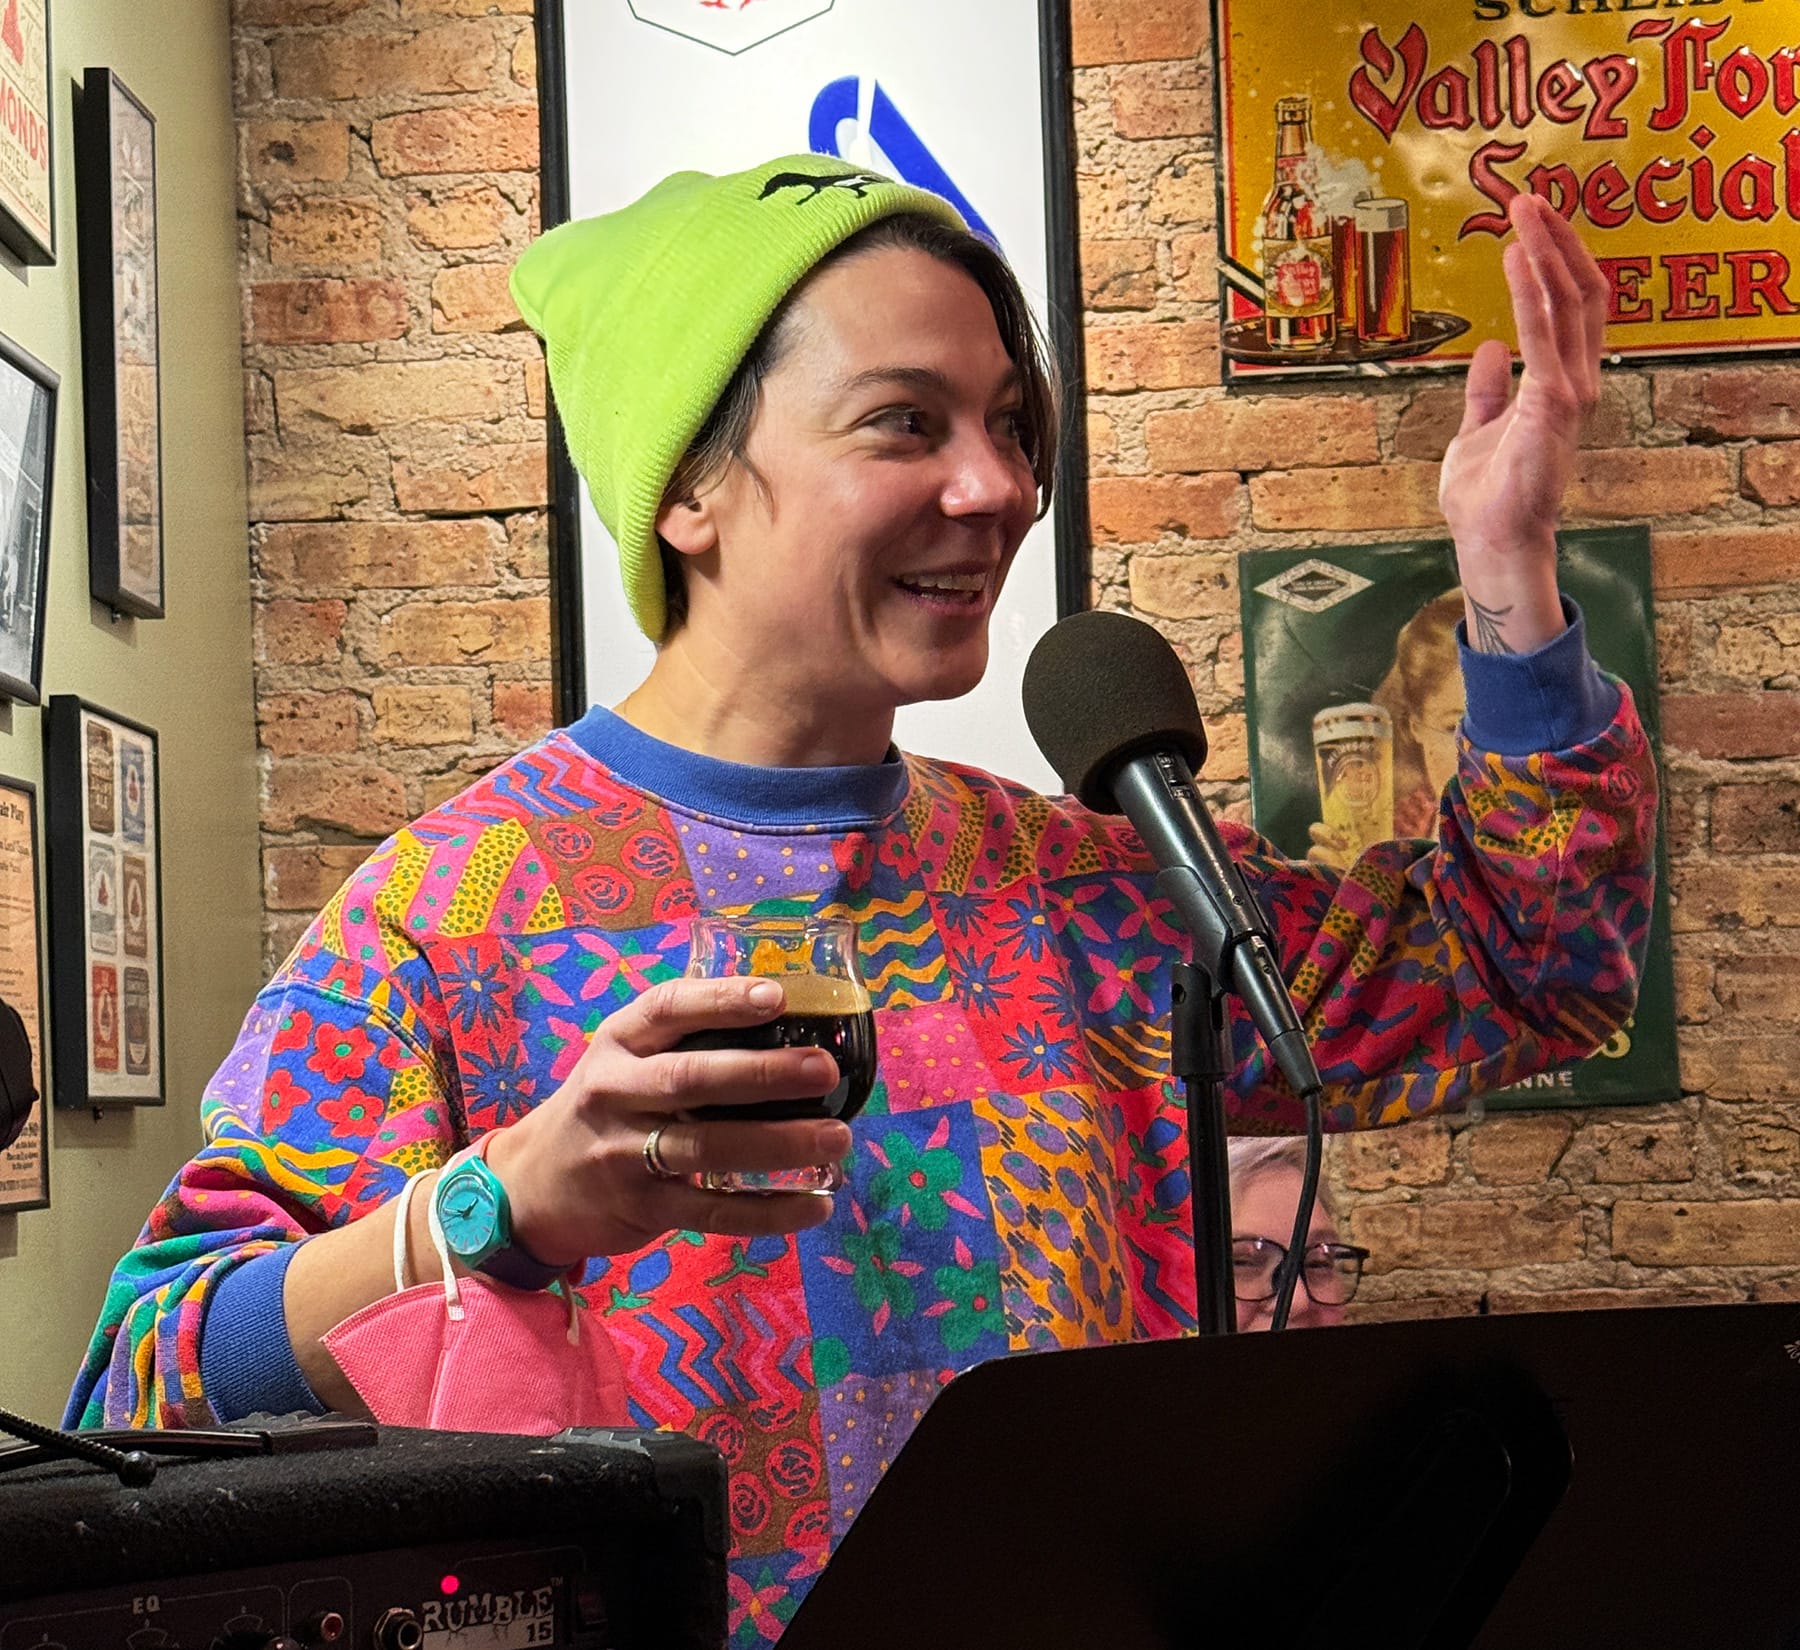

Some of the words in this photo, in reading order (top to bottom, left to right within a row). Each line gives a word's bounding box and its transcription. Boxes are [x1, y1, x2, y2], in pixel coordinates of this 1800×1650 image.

[1349, 21, 1638, 142] Valley
[1596, 249, 1800, 325] EER
[1499, 1069, 1573, 1091] NNE
[132, 1595, 161, 1615] EQ
[422, 1585, 554, 1633] RUMBLE
[526, 1620, 551, 1643] 15
